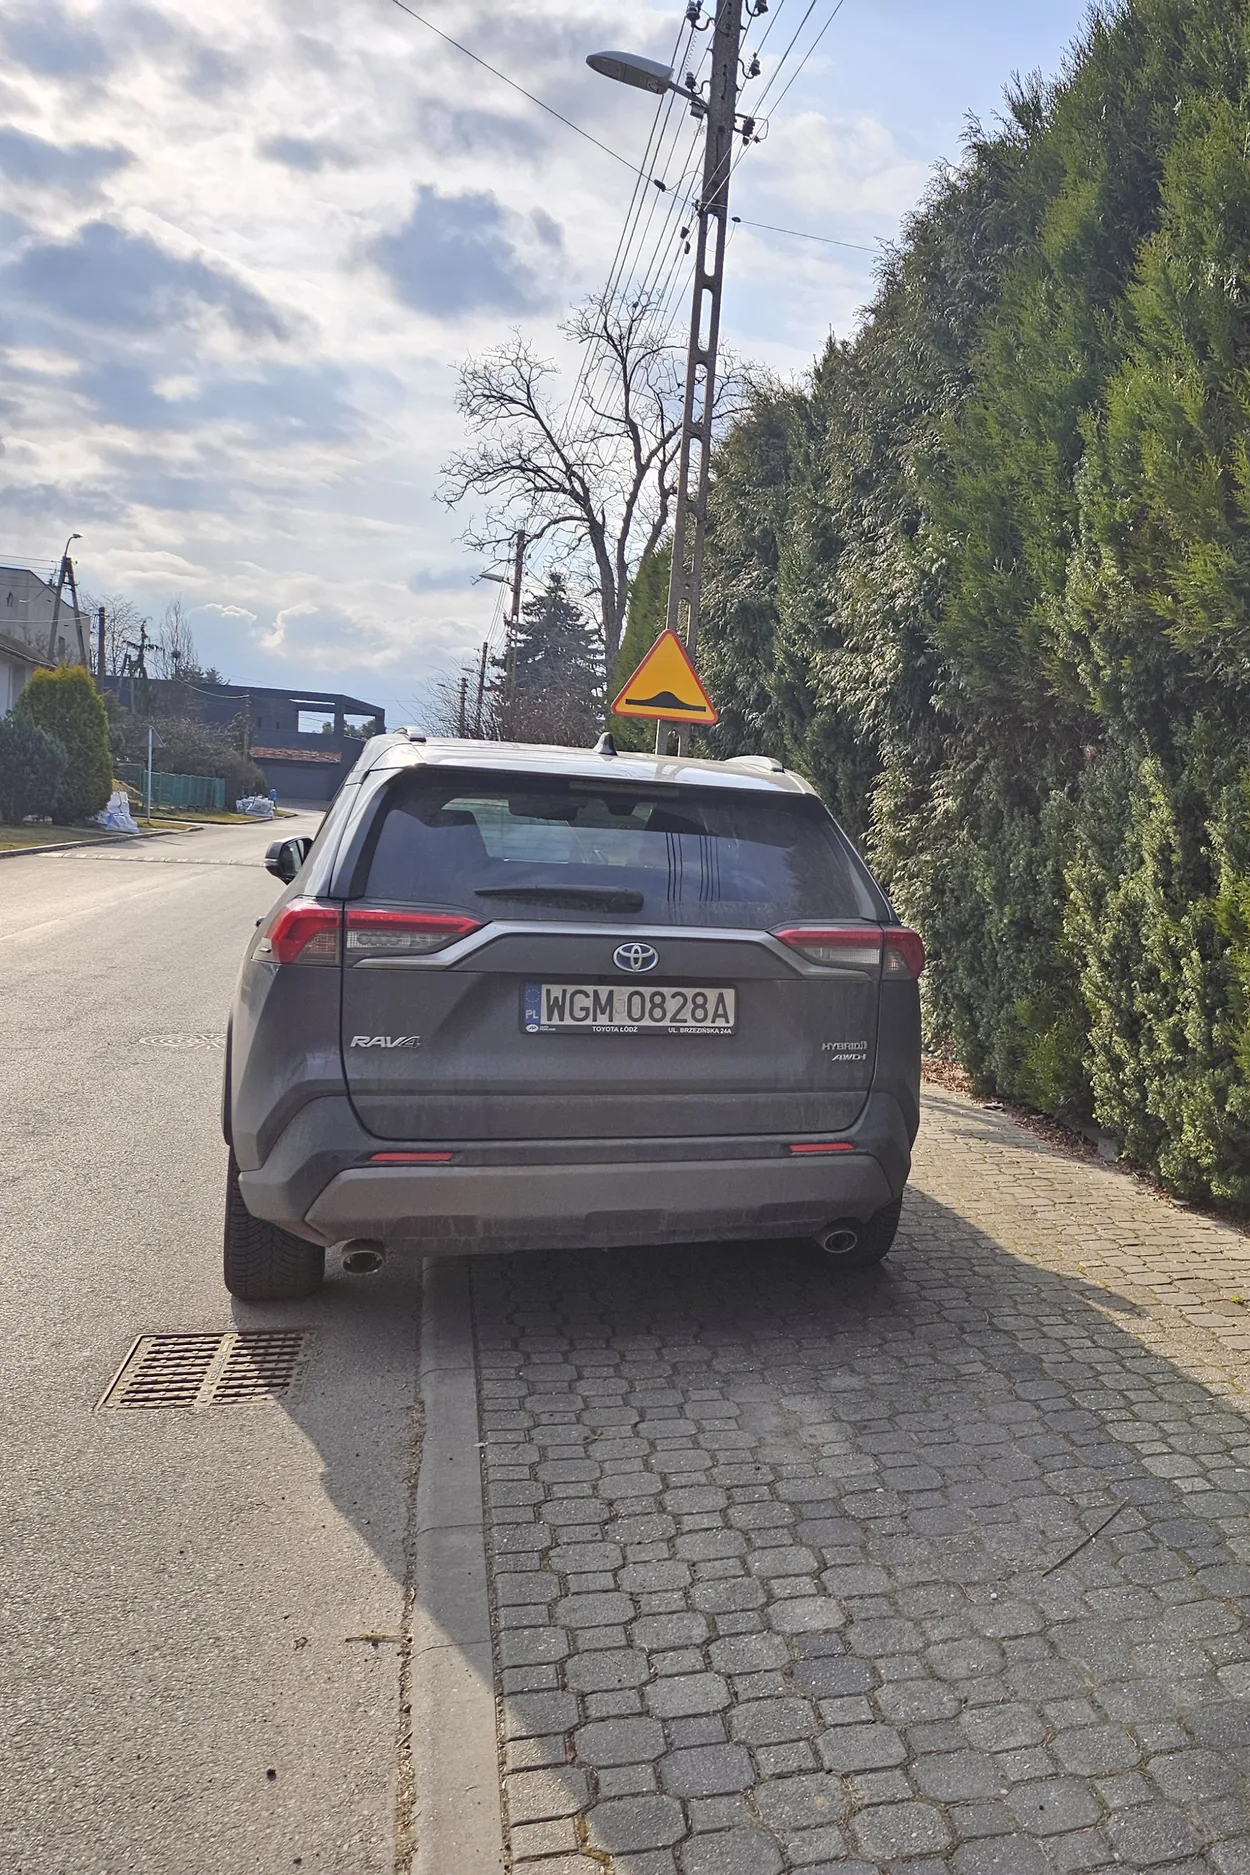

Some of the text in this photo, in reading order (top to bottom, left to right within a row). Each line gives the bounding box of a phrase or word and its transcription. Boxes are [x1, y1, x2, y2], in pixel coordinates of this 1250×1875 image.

[545, 988, 730, 1024] WGM 0828A
[525, 1010, 539, 1019] PL
[592, 1025, 638, 1033] TOYOTA ŁÓDŹ
[349, 1035, 421, 1048] RAV4
